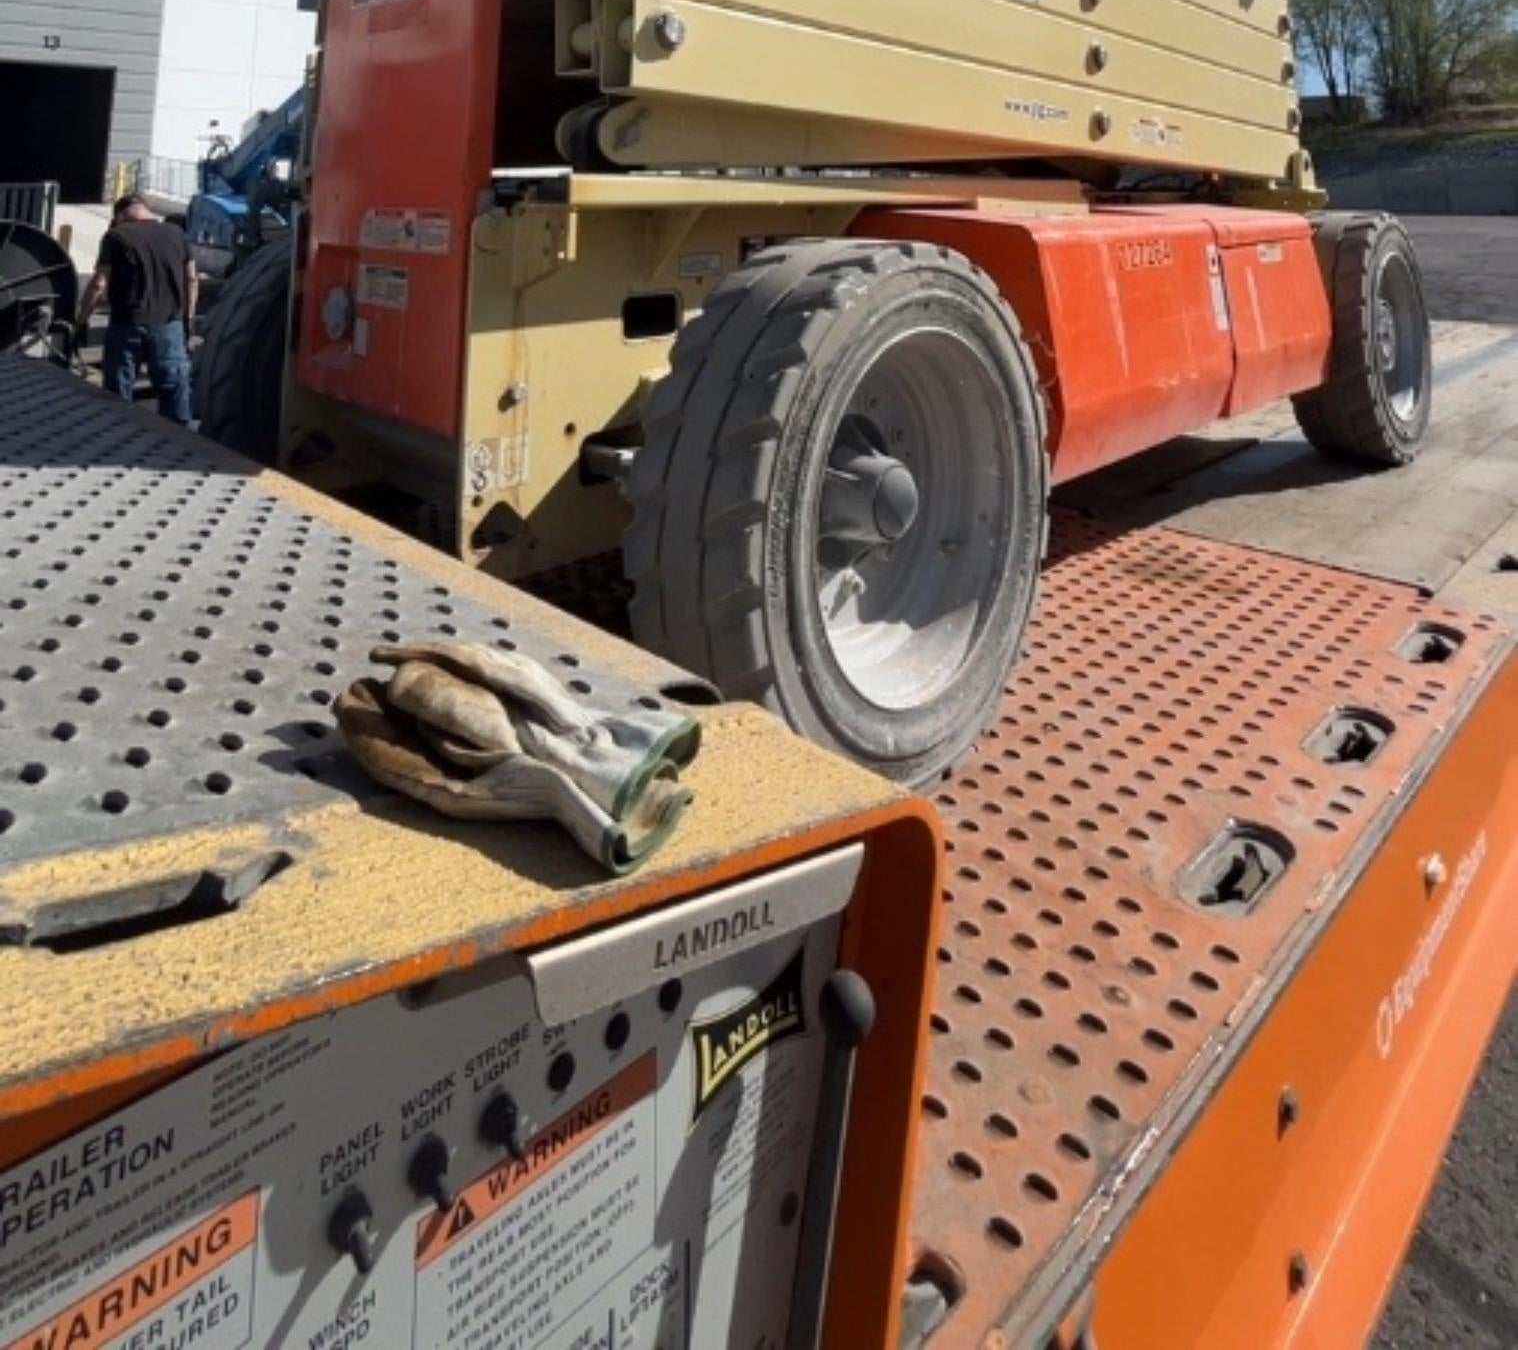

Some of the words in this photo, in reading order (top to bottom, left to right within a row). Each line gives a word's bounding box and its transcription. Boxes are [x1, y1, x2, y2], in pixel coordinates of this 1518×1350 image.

[653, 900, 775, 970] LANDOLL
[463, 1022, 531, 1079] STROBE
[473, 1049, 521, 1093] LIGHT
[700, 991, 799, 1100] LANDOLL
[400, 1070, 457, 1119] WORK
[401, 1093, 455, 1142] LIGHT
[0, 1124, 126, 1213] RAILER
[319, 1122, 385, 1174] PANEL
[320, 1141, 381, 1196] LIGHT
[487, 1091, 611, 1201] WARNING
[0, 1127, 175, 1248] PERATION
[174, 1272, 232, 1323] TAIL
[308, 1289, 377, 1350] WINCH
